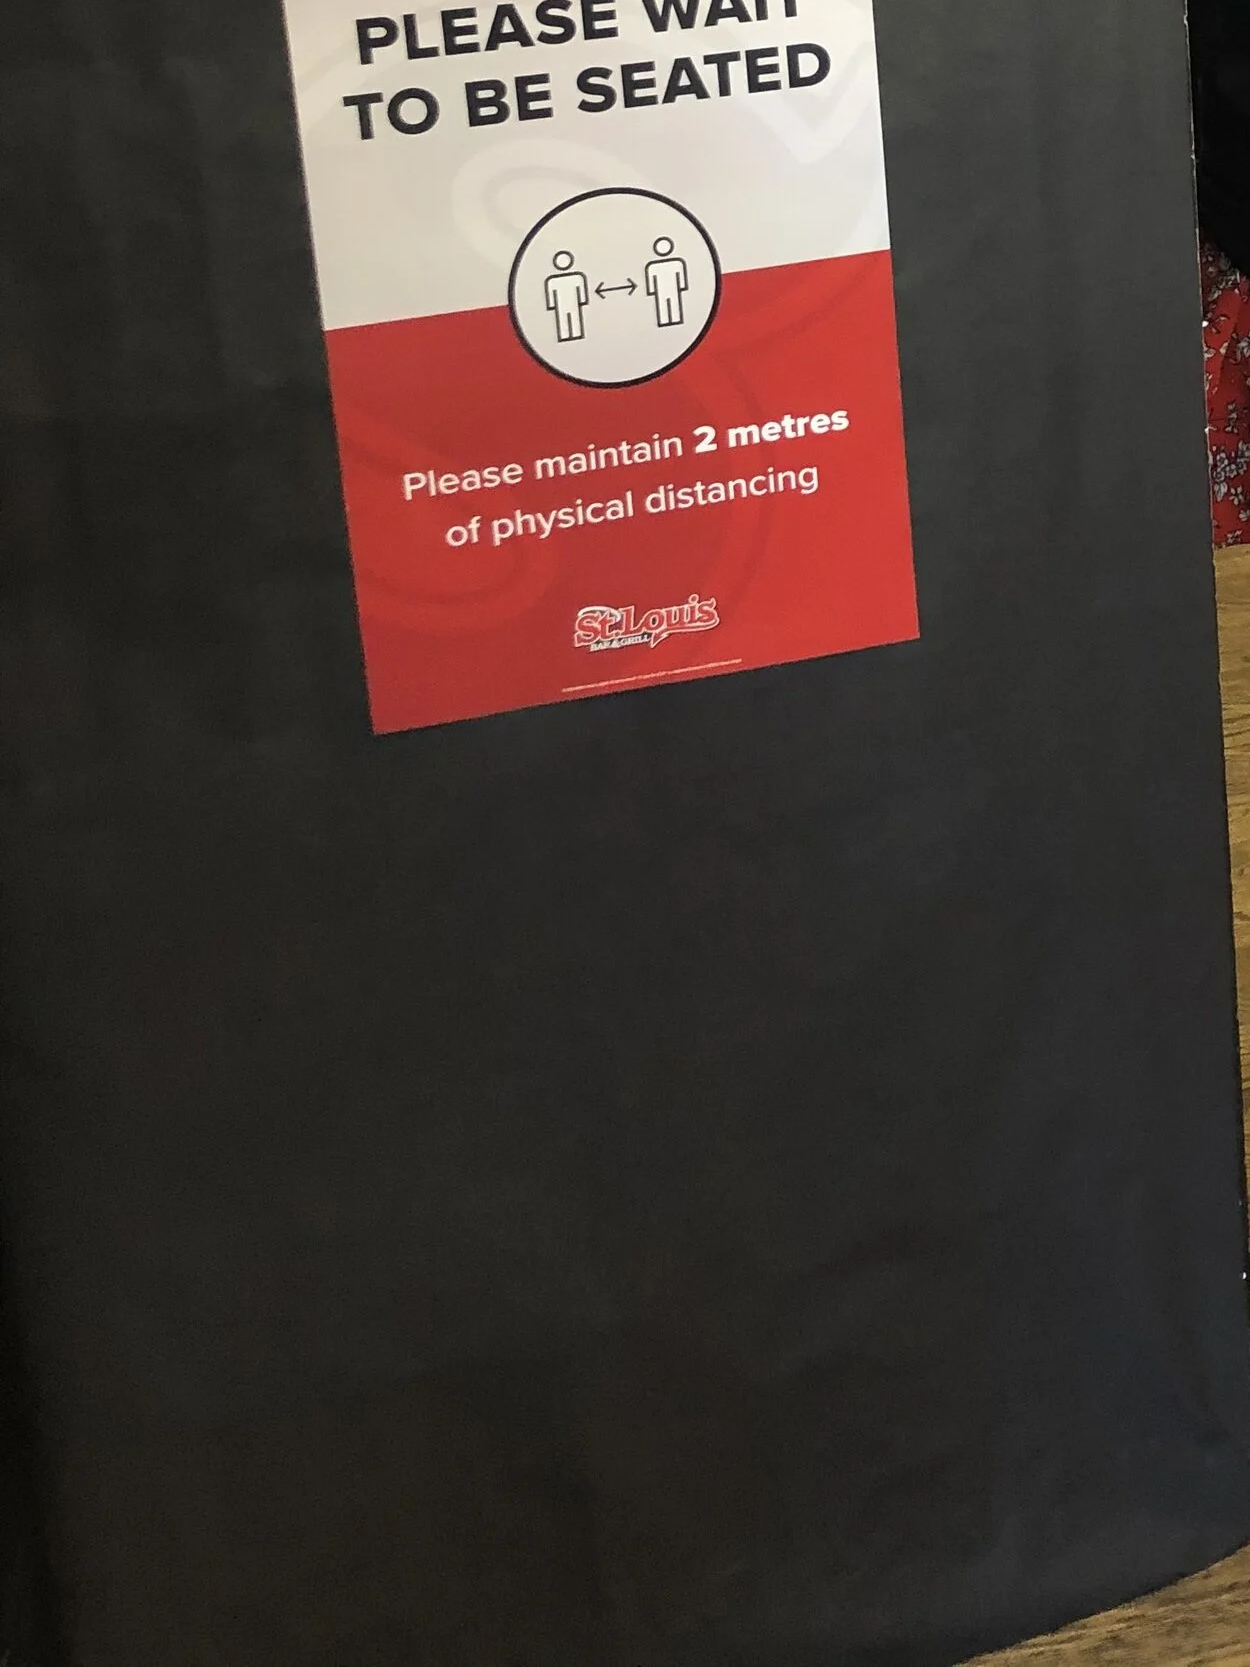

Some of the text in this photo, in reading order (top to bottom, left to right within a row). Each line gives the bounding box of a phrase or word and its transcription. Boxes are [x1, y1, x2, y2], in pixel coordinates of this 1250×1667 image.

[343, 42, 832, 141] TO BE SEATED
[402, 407, 850, 501] Please maintain 2 metres
[445, 463, 819, 548] of physical distancing
